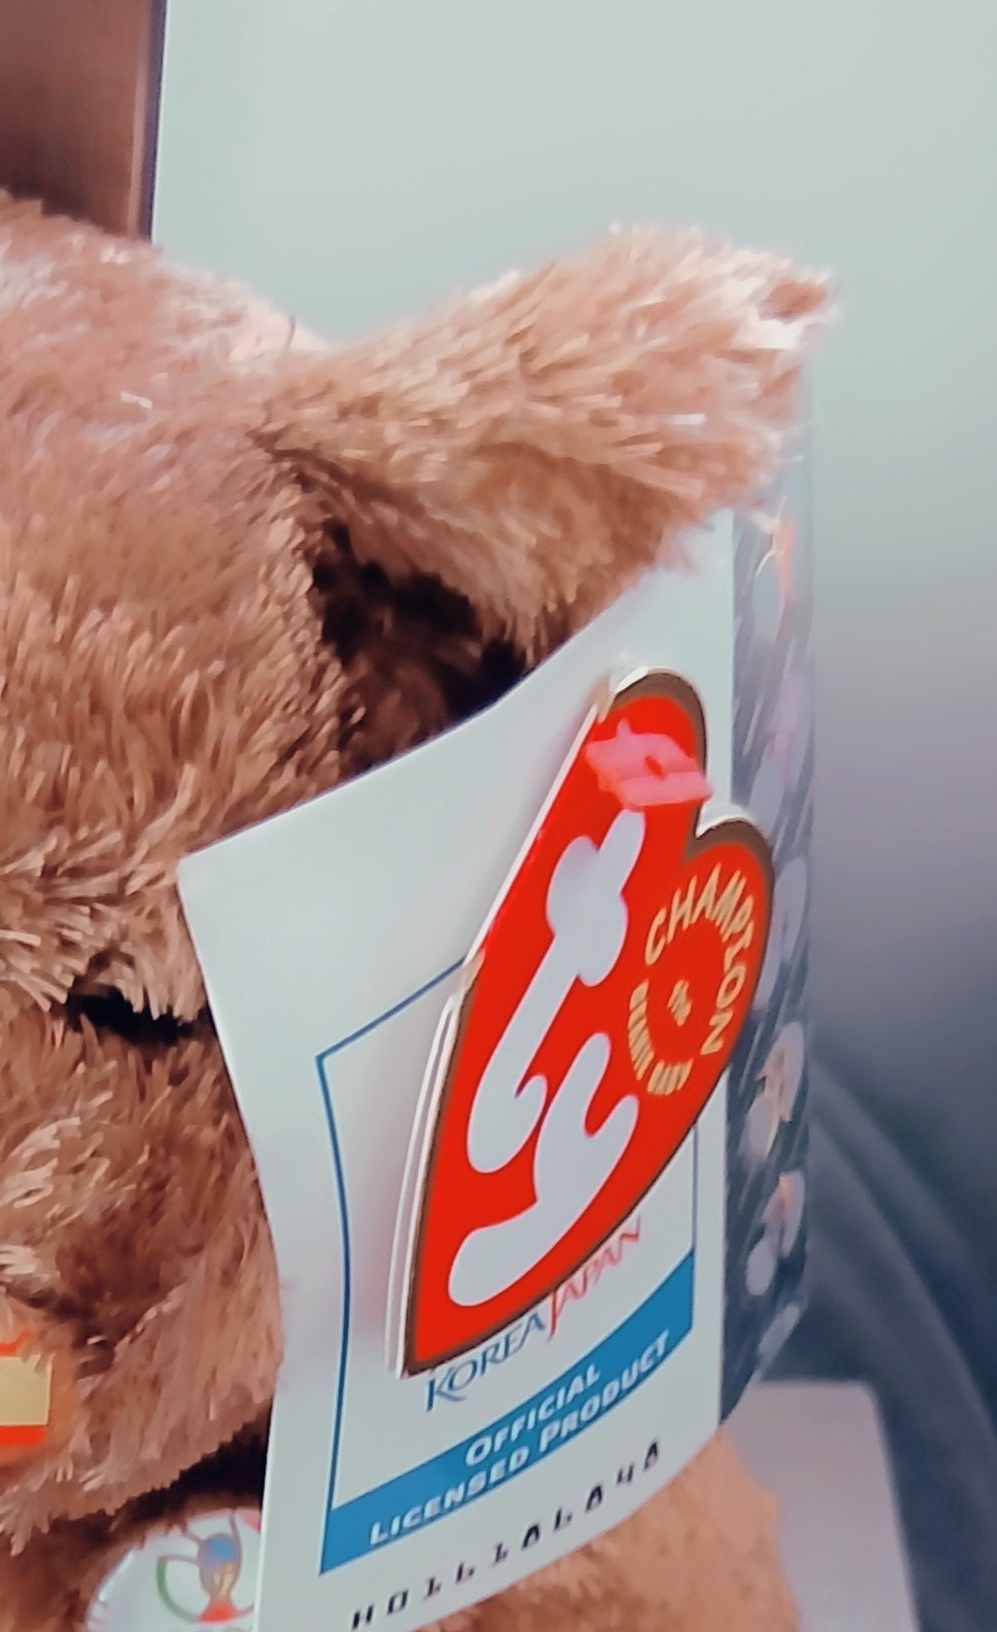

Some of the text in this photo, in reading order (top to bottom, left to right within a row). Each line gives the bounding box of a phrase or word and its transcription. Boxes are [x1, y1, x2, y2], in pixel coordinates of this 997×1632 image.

[644, 862, 754, 1056] CHAMPION
[425, 1215, 642, 1412] KOREA JAPAN
[368, 1327, 671, 1547] LICENSED PRODUCT
[464, 1361, 602, 1468] OFFICIAL
